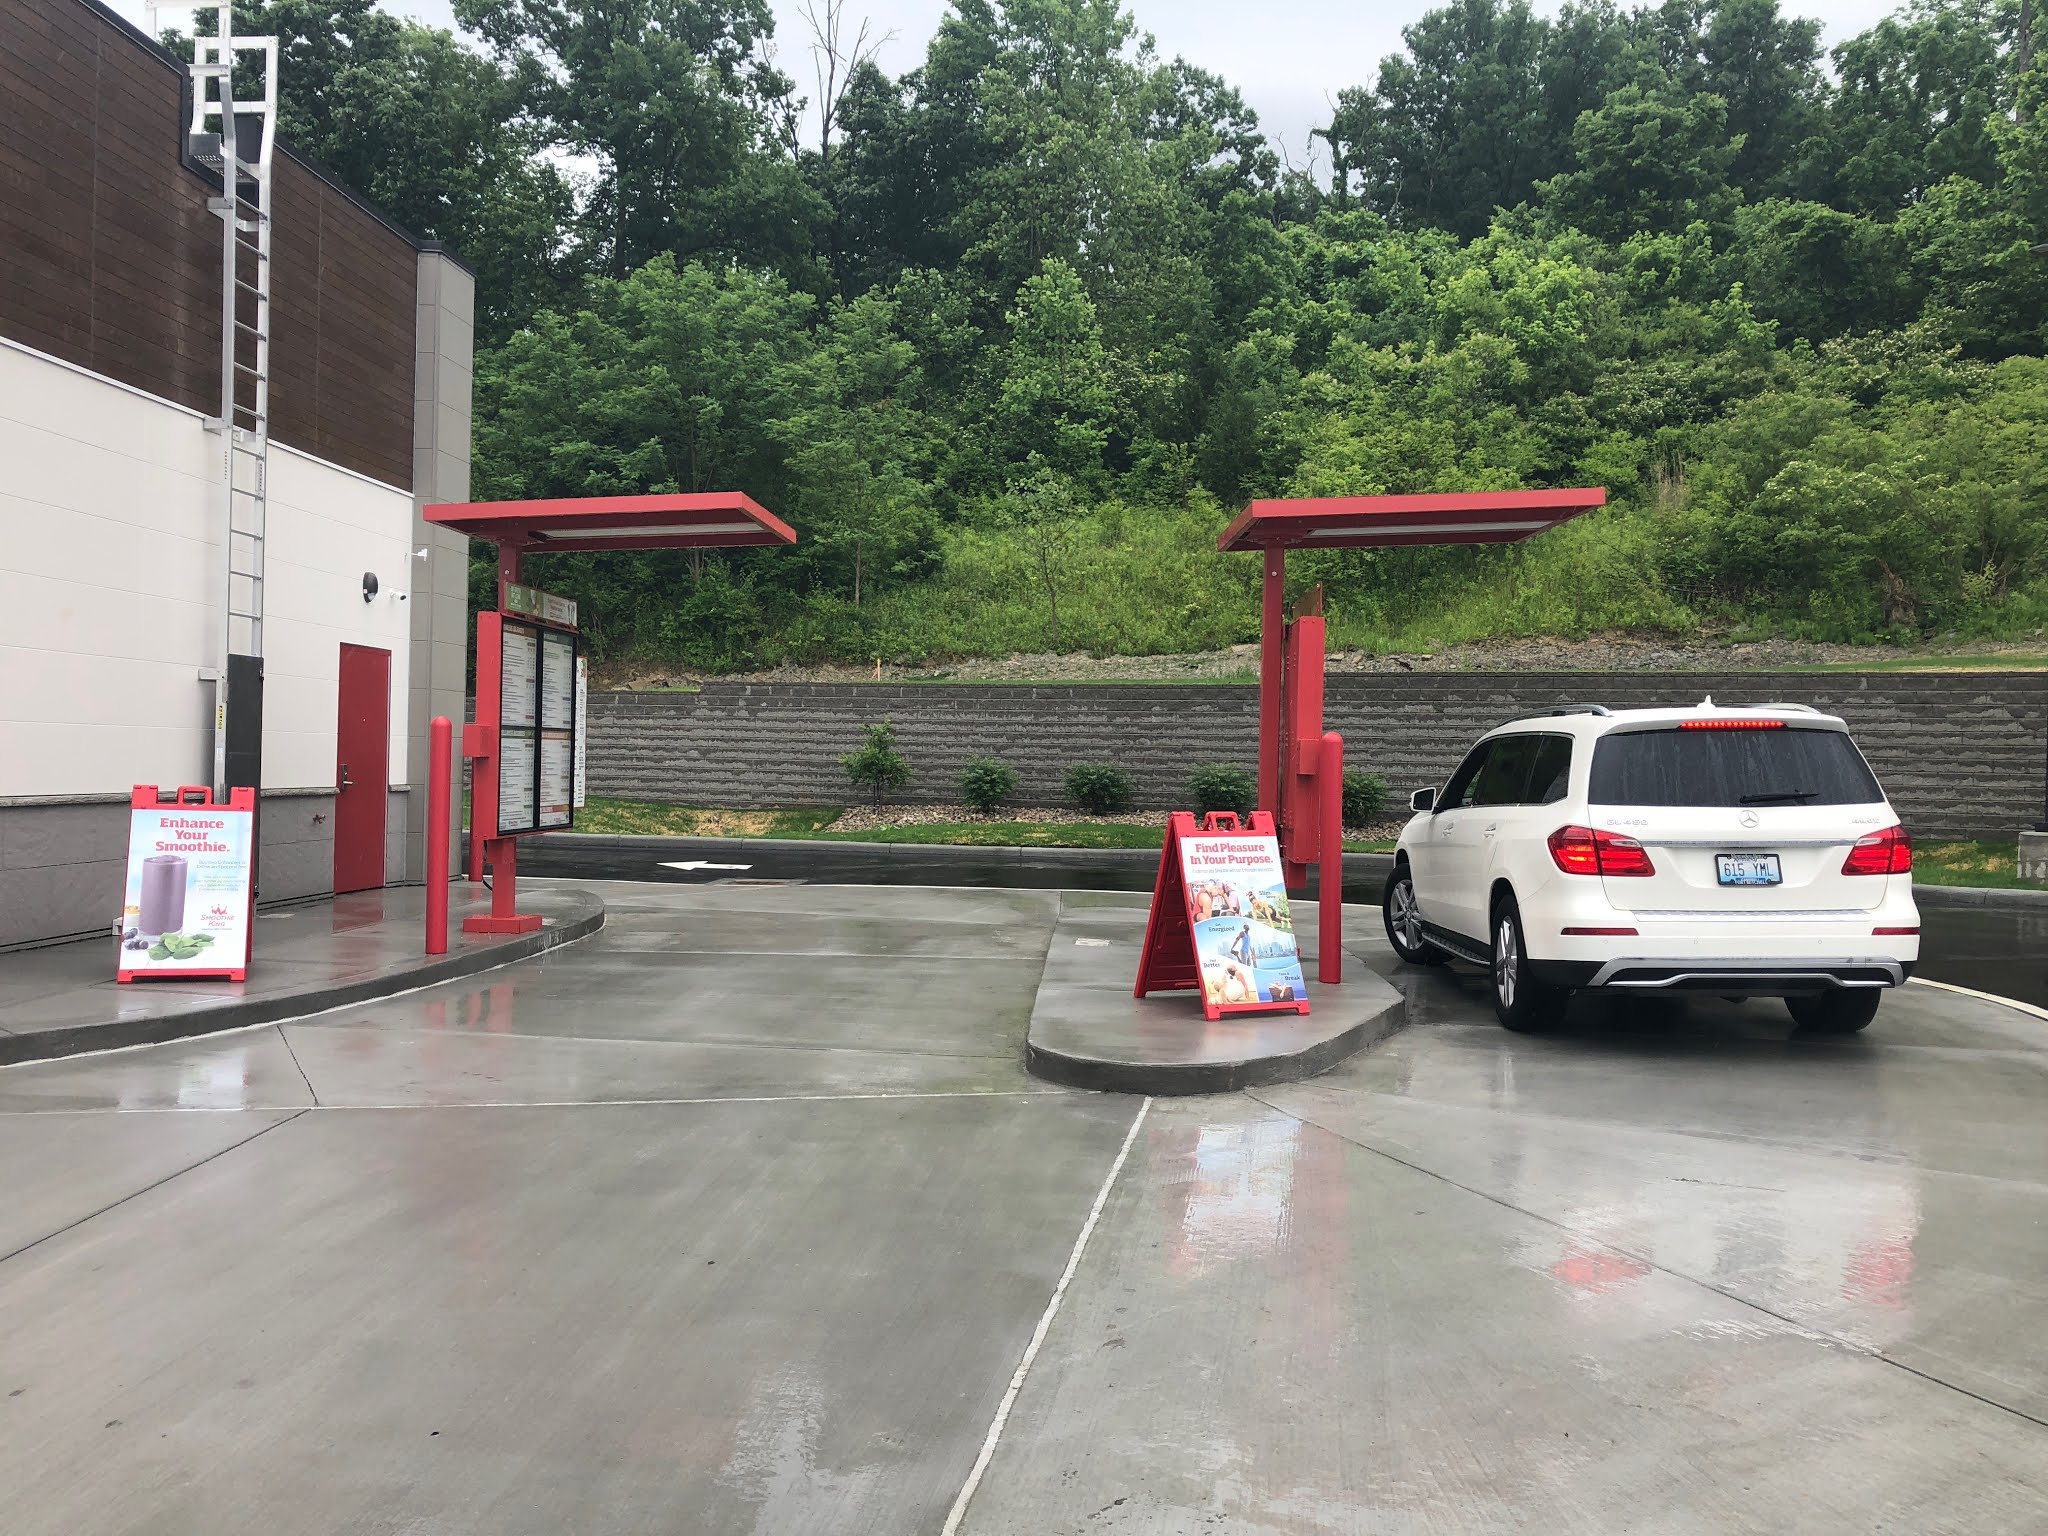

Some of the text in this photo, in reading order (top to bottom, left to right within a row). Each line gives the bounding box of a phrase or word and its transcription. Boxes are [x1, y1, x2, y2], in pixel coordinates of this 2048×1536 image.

[160, 818, 224, 828] Enhance
[175, 830, 208, 840] Your
[155, 841, 230, 852] Smoothie.
[1195, 842, 1265, 853] Find Pleasure
[1190, 854, 1273, 866] In Your Purpose.
[1723, 863, 1774, 877] 615 YML
